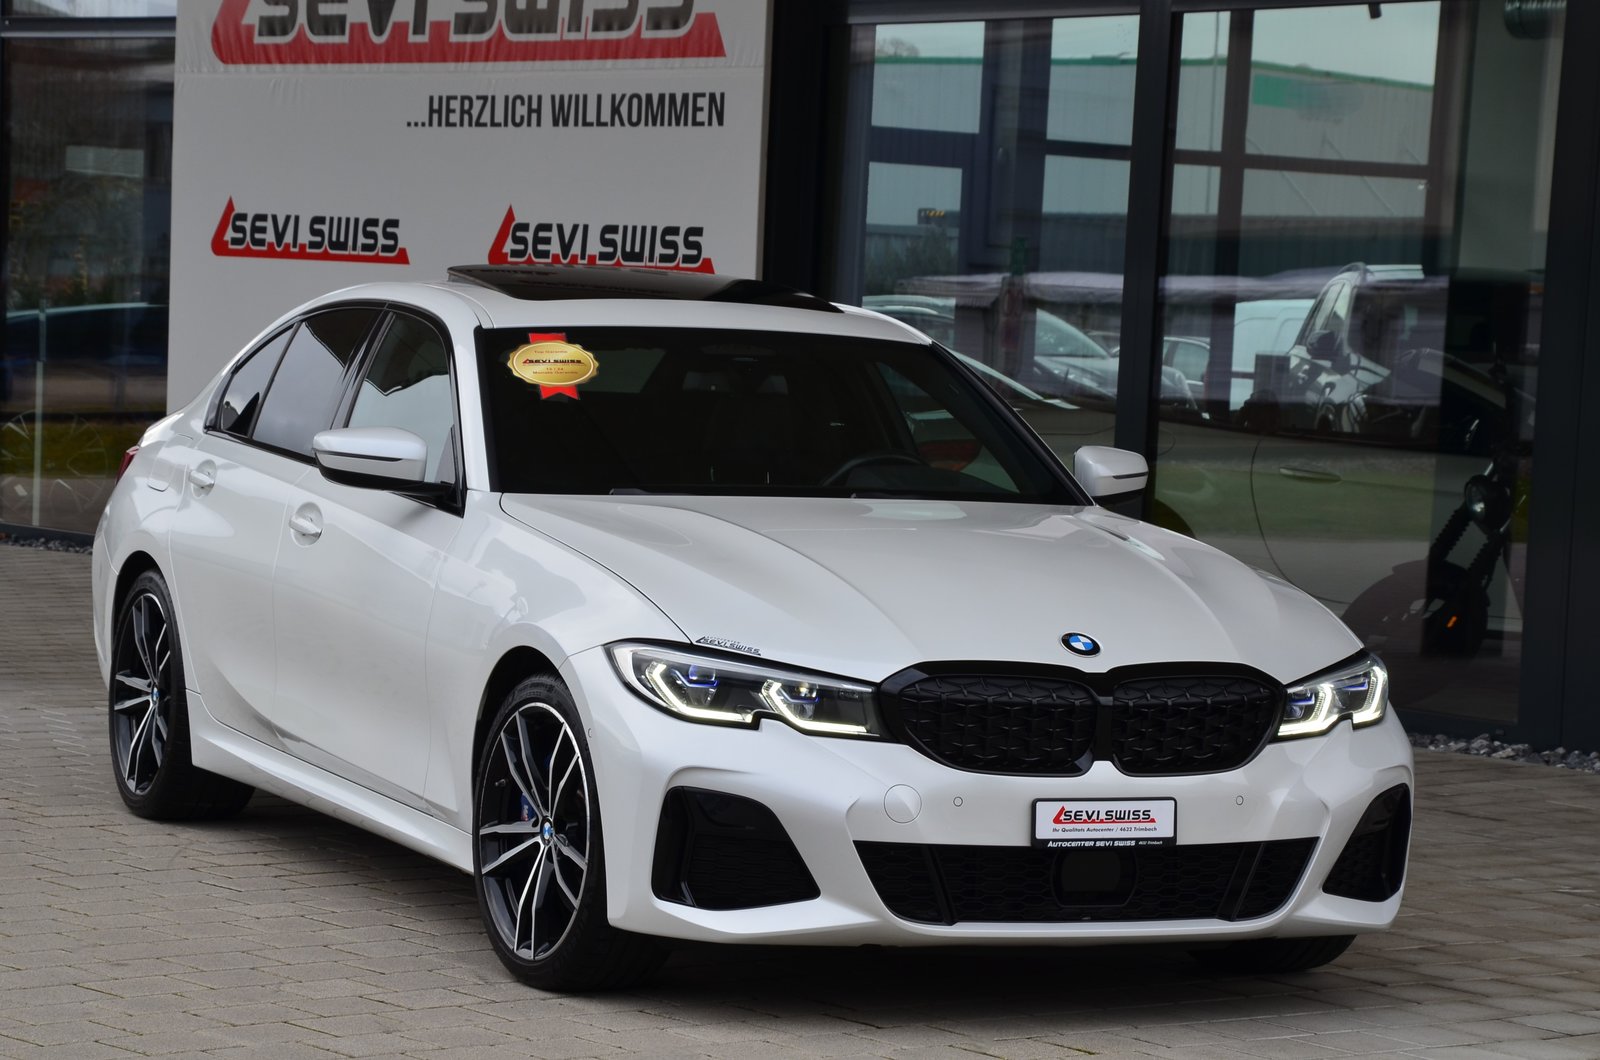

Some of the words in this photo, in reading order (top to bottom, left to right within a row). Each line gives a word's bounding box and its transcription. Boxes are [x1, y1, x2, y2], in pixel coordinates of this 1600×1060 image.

[406, 94, 543, 128] ...HERZLICH
[550, 92, 726, 128] WILLKOMMEN
[229, 212, 300, 249] SEVI
[308, 215, 400, 254] SWISS
[509, 222, 590, 261] SEVI
[599, 224, 704, 265] SWISS
[1063, 810, 1101, 821] SEVI
[1104, 809, 1151, 821] SWISS
